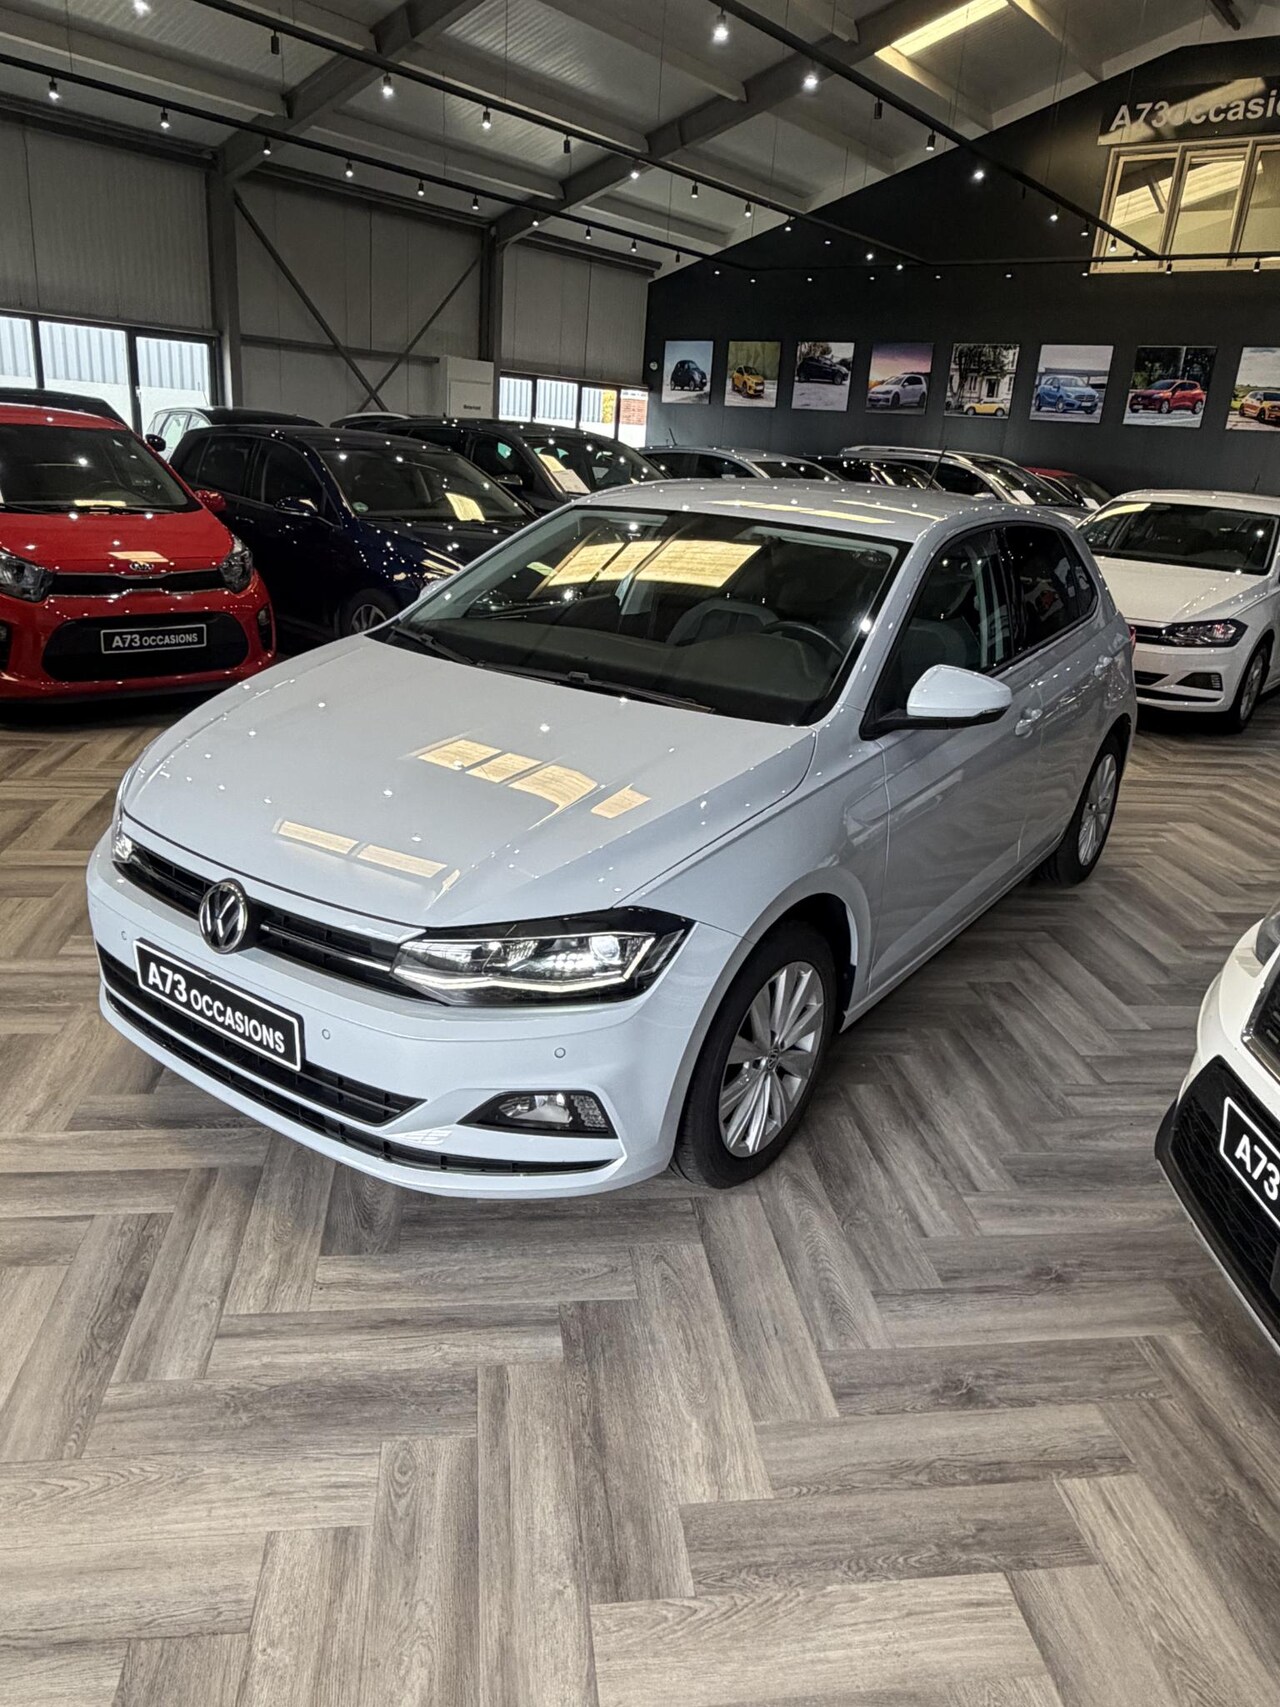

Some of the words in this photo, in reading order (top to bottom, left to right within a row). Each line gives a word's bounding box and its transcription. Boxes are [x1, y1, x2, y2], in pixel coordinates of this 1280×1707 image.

[1108, 89, 1280, 132] A73occasi
[112, 634, 140, 648] A73
[142, 633, 198, 646] OCCASIONS
[148, 962, 187, 1002] A73
[190, 989, 285, 1053] OCCASIONS
[1234, 1133, 1280, 1200] A73
